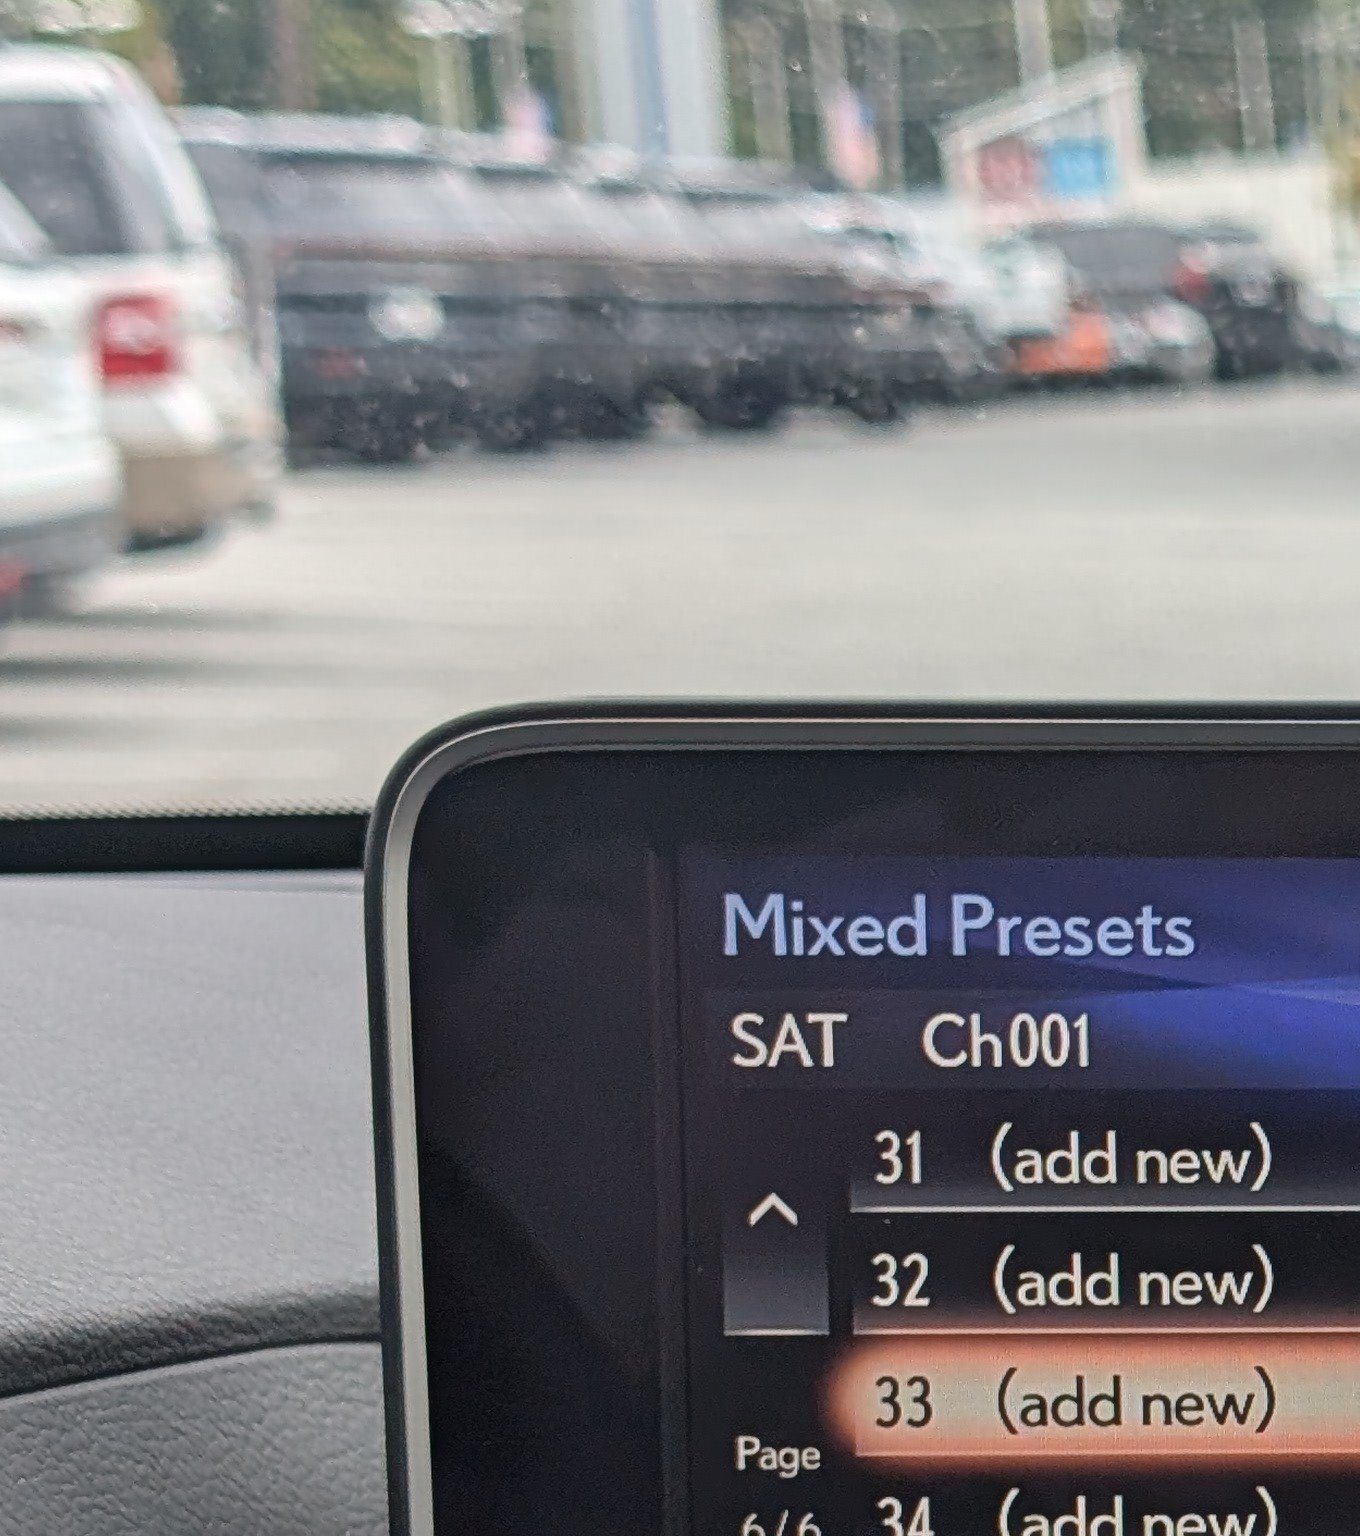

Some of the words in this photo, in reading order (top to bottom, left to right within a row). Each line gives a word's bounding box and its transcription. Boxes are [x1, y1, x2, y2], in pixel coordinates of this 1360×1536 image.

[722, 892, 927, 957] Mixed
[951, 892, 1196, 957] Presets
[730, 1013, 848, 1069] SAT
[922, 1013, 1090, 1069] Ch001
[873, 1130, 923, 1185] 31
[991, 1122, 1118, 1192] (add
[1135, 1122, 1273, 1192] new)
[871, 1252, 930, 1308] 32
[994, 1245, 1120, 1314] (add
[1138, 1245, 1275, 1314] new)
[874, 1375, 933, 1428] 33
[998, 1367, 1122, 1435] (add
[1141, 1366, 1276, 1433] new)
[735, 1436, 822, 1478] Page
